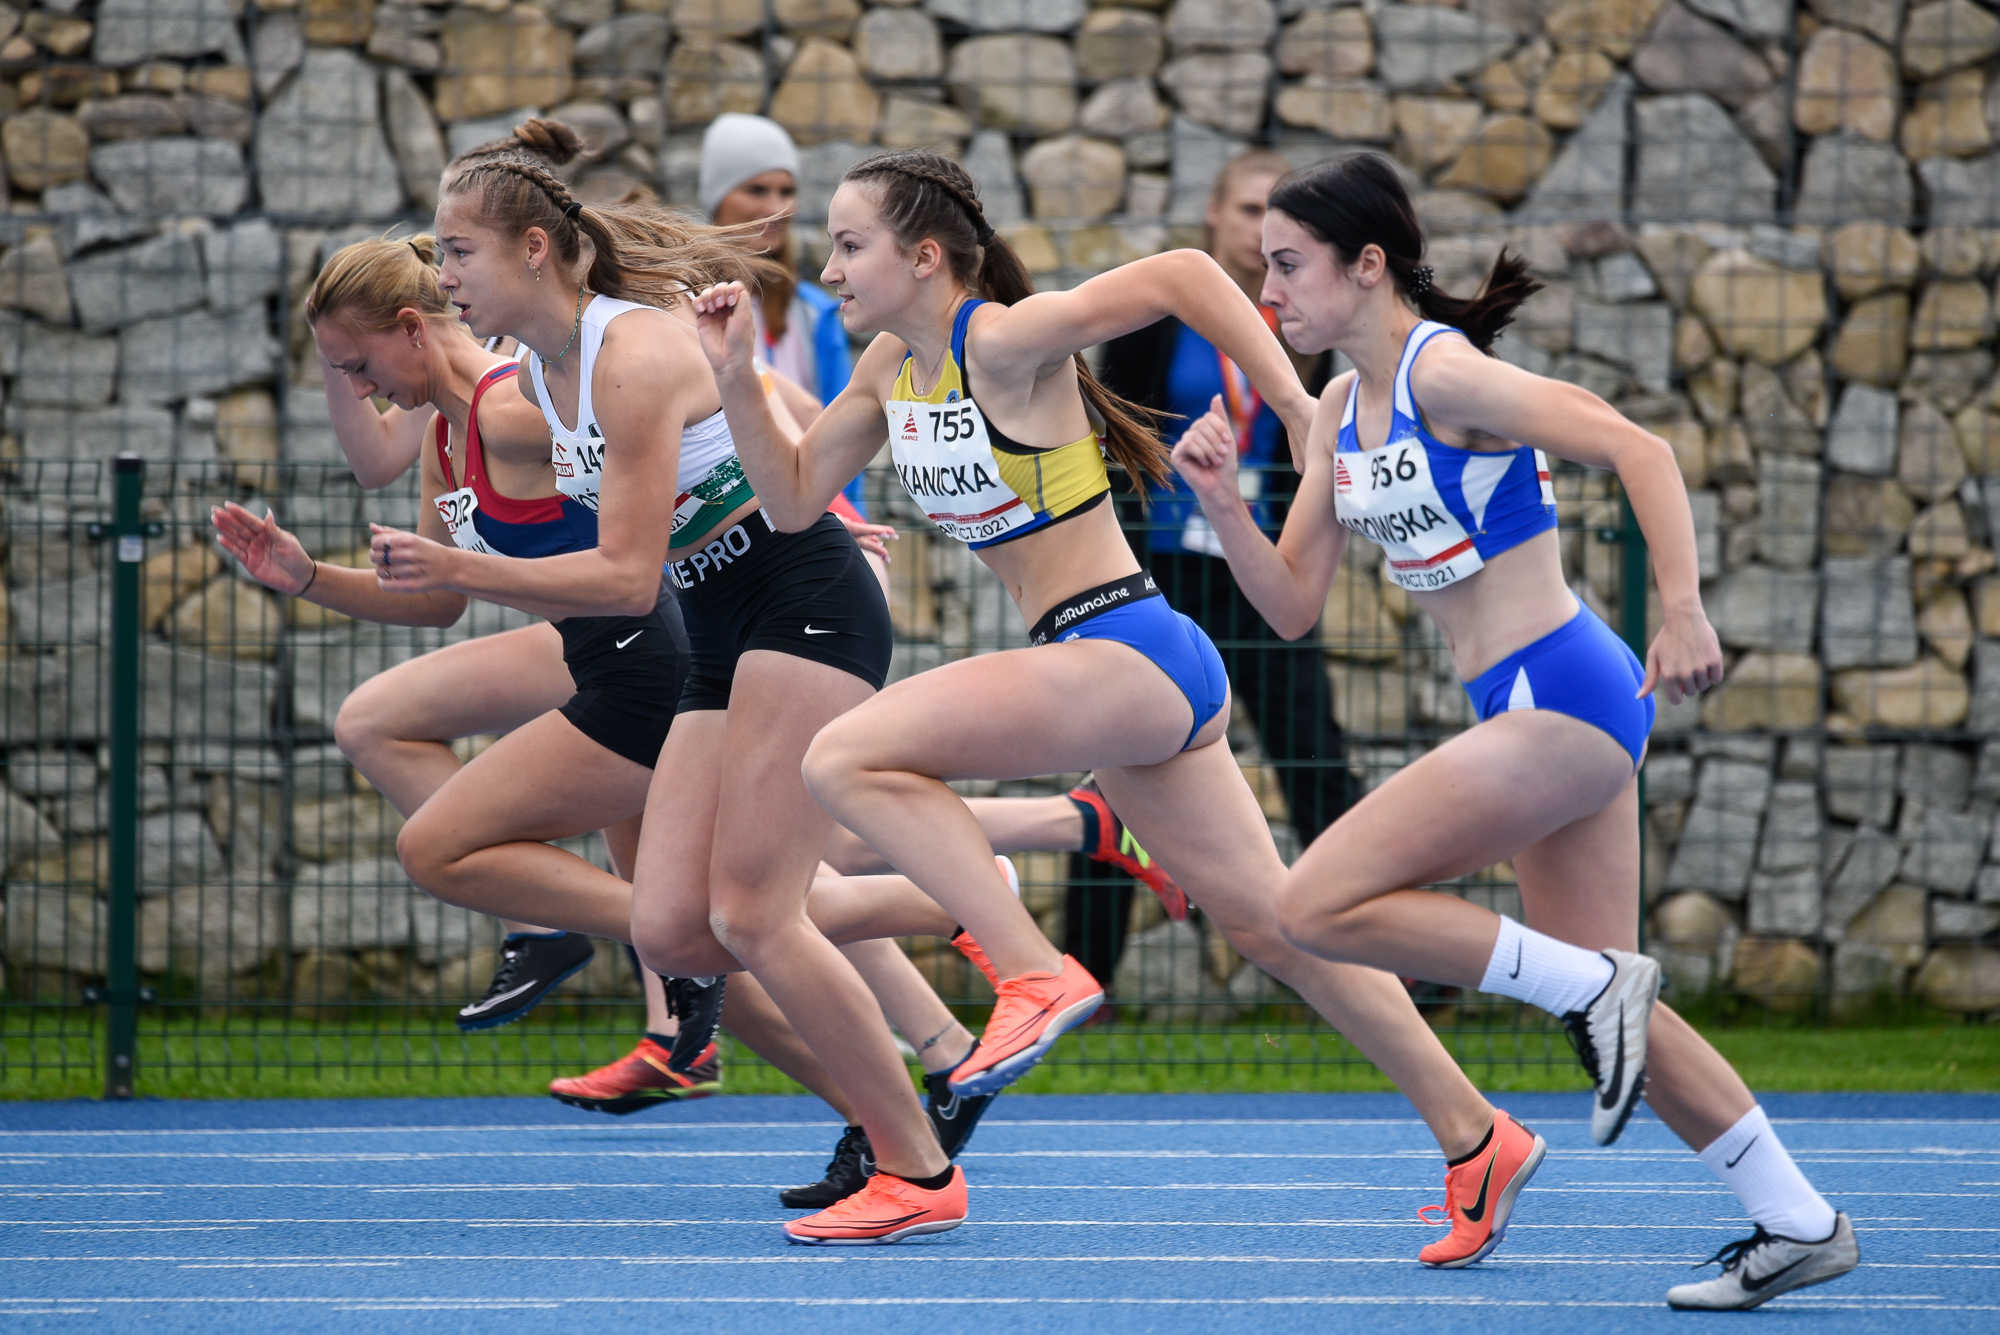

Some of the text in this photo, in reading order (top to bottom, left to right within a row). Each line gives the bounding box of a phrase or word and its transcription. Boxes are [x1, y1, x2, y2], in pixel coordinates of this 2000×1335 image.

[929, 407, 974, 442] 755
[897, 463, 997, 496] KANICKA
[1371, 449, 1416, 490] 956
[976, 516, 1010, 538] 2021
[690, 524, 751, 582] PRO
[1424, 566, 1456, 588] 2021
